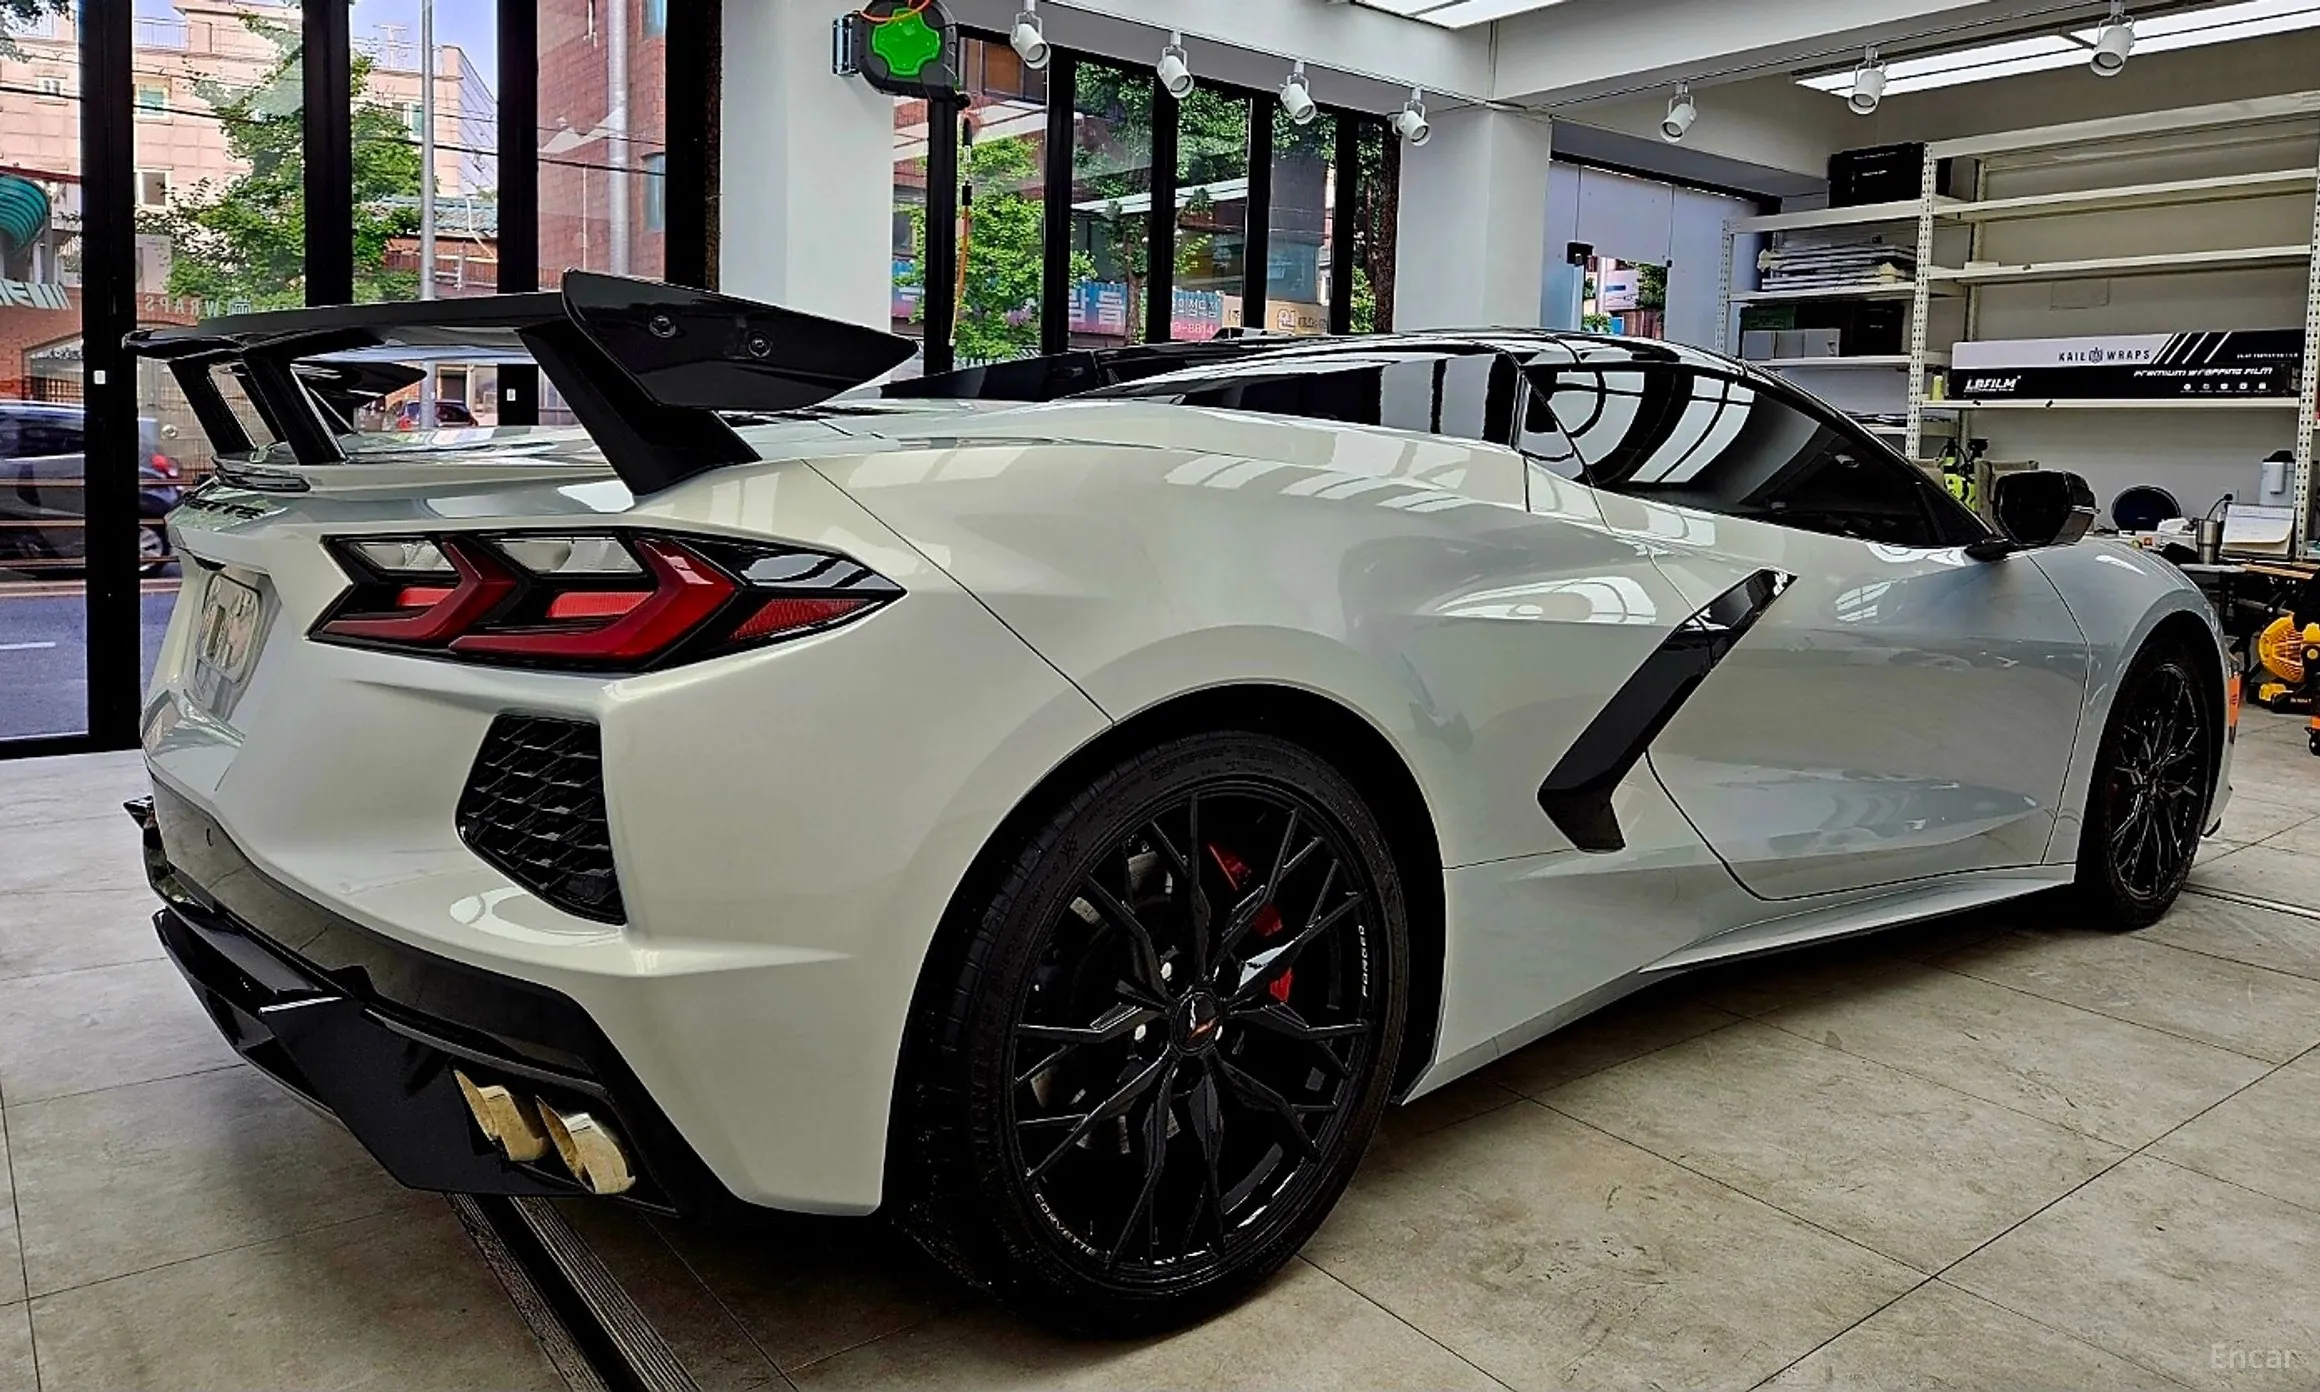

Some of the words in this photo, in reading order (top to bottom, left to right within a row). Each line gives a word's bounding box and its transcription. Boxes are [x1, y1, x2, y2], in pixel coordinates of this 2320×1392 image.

[2058, 350, 2086, 362] KAIL
[2107, 349, 2150, 361] WRAPS
[1358, 925, 1368, 998] FORGED
[1034, 1193, 1097, 1256] CORVETTE
